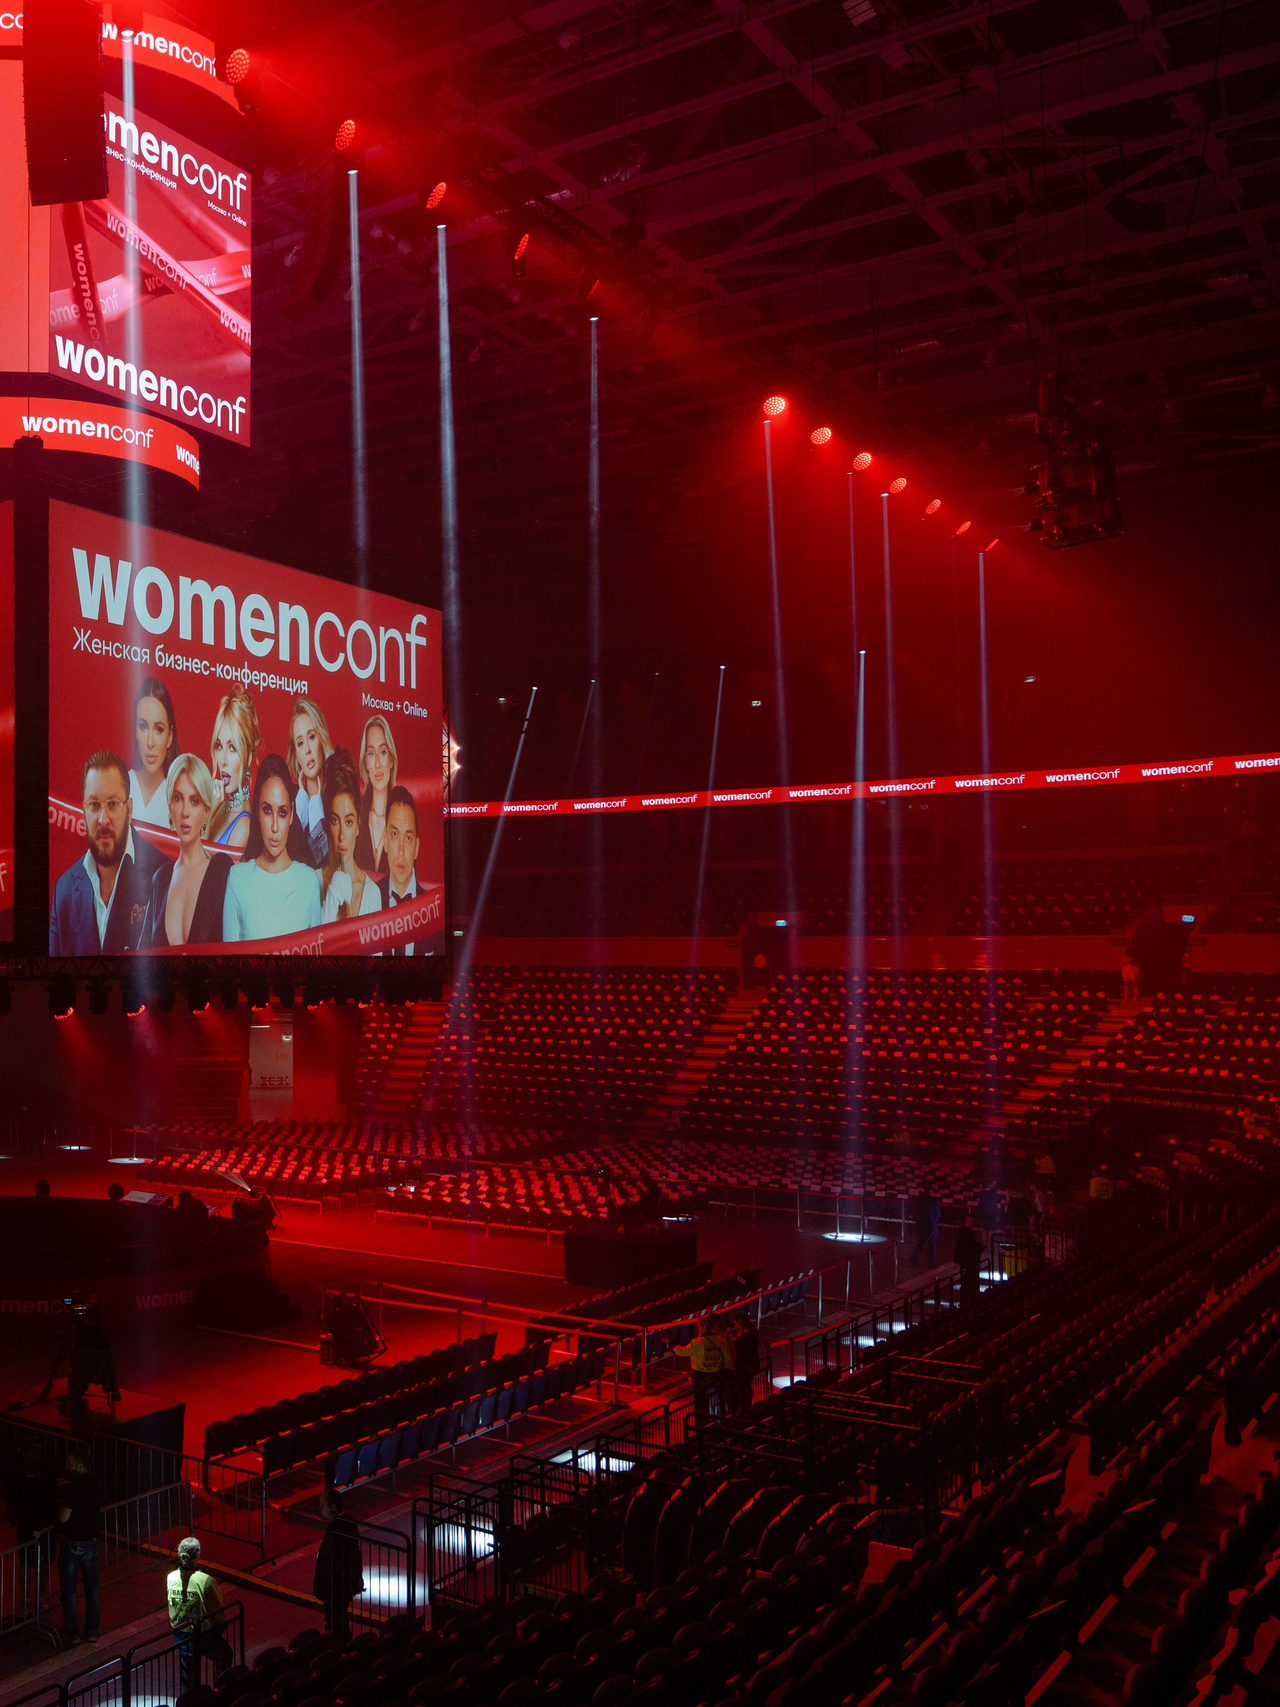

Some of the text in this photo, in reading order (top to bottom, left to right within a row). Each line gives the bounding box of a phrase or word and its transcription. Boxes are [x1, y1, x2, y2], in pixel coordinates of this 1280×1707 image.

[232, 213, 247, 228] Online
[107, 212, 191, 290] womenconf
[55, 334, 246, 434] womenconf
[22, 416, 154, 449] womenconf
[72, 547, 428, 690] womenconf
[72, 626, 308, 695] Женская бизнес-конференция
[361, 692, 394, 712] Москва
[403, 700, 428, 719] Online
[1045, 769, 1120, 783] womenconf
[1141, 761, 1213, 776] womenconf
[869, 780, 935, 793] womenconf
[955, 775, 1025, 788] womenconf
[713, 789, 772, 802] womenconf
[789, 785, 851, 798] womenconf
[503, 802, 558, 812] womenconf
[573, 799, 627, 810] womenconf
[642, 794, 697, 806] womenconf
[358, 894, 440, 944] womenconf
